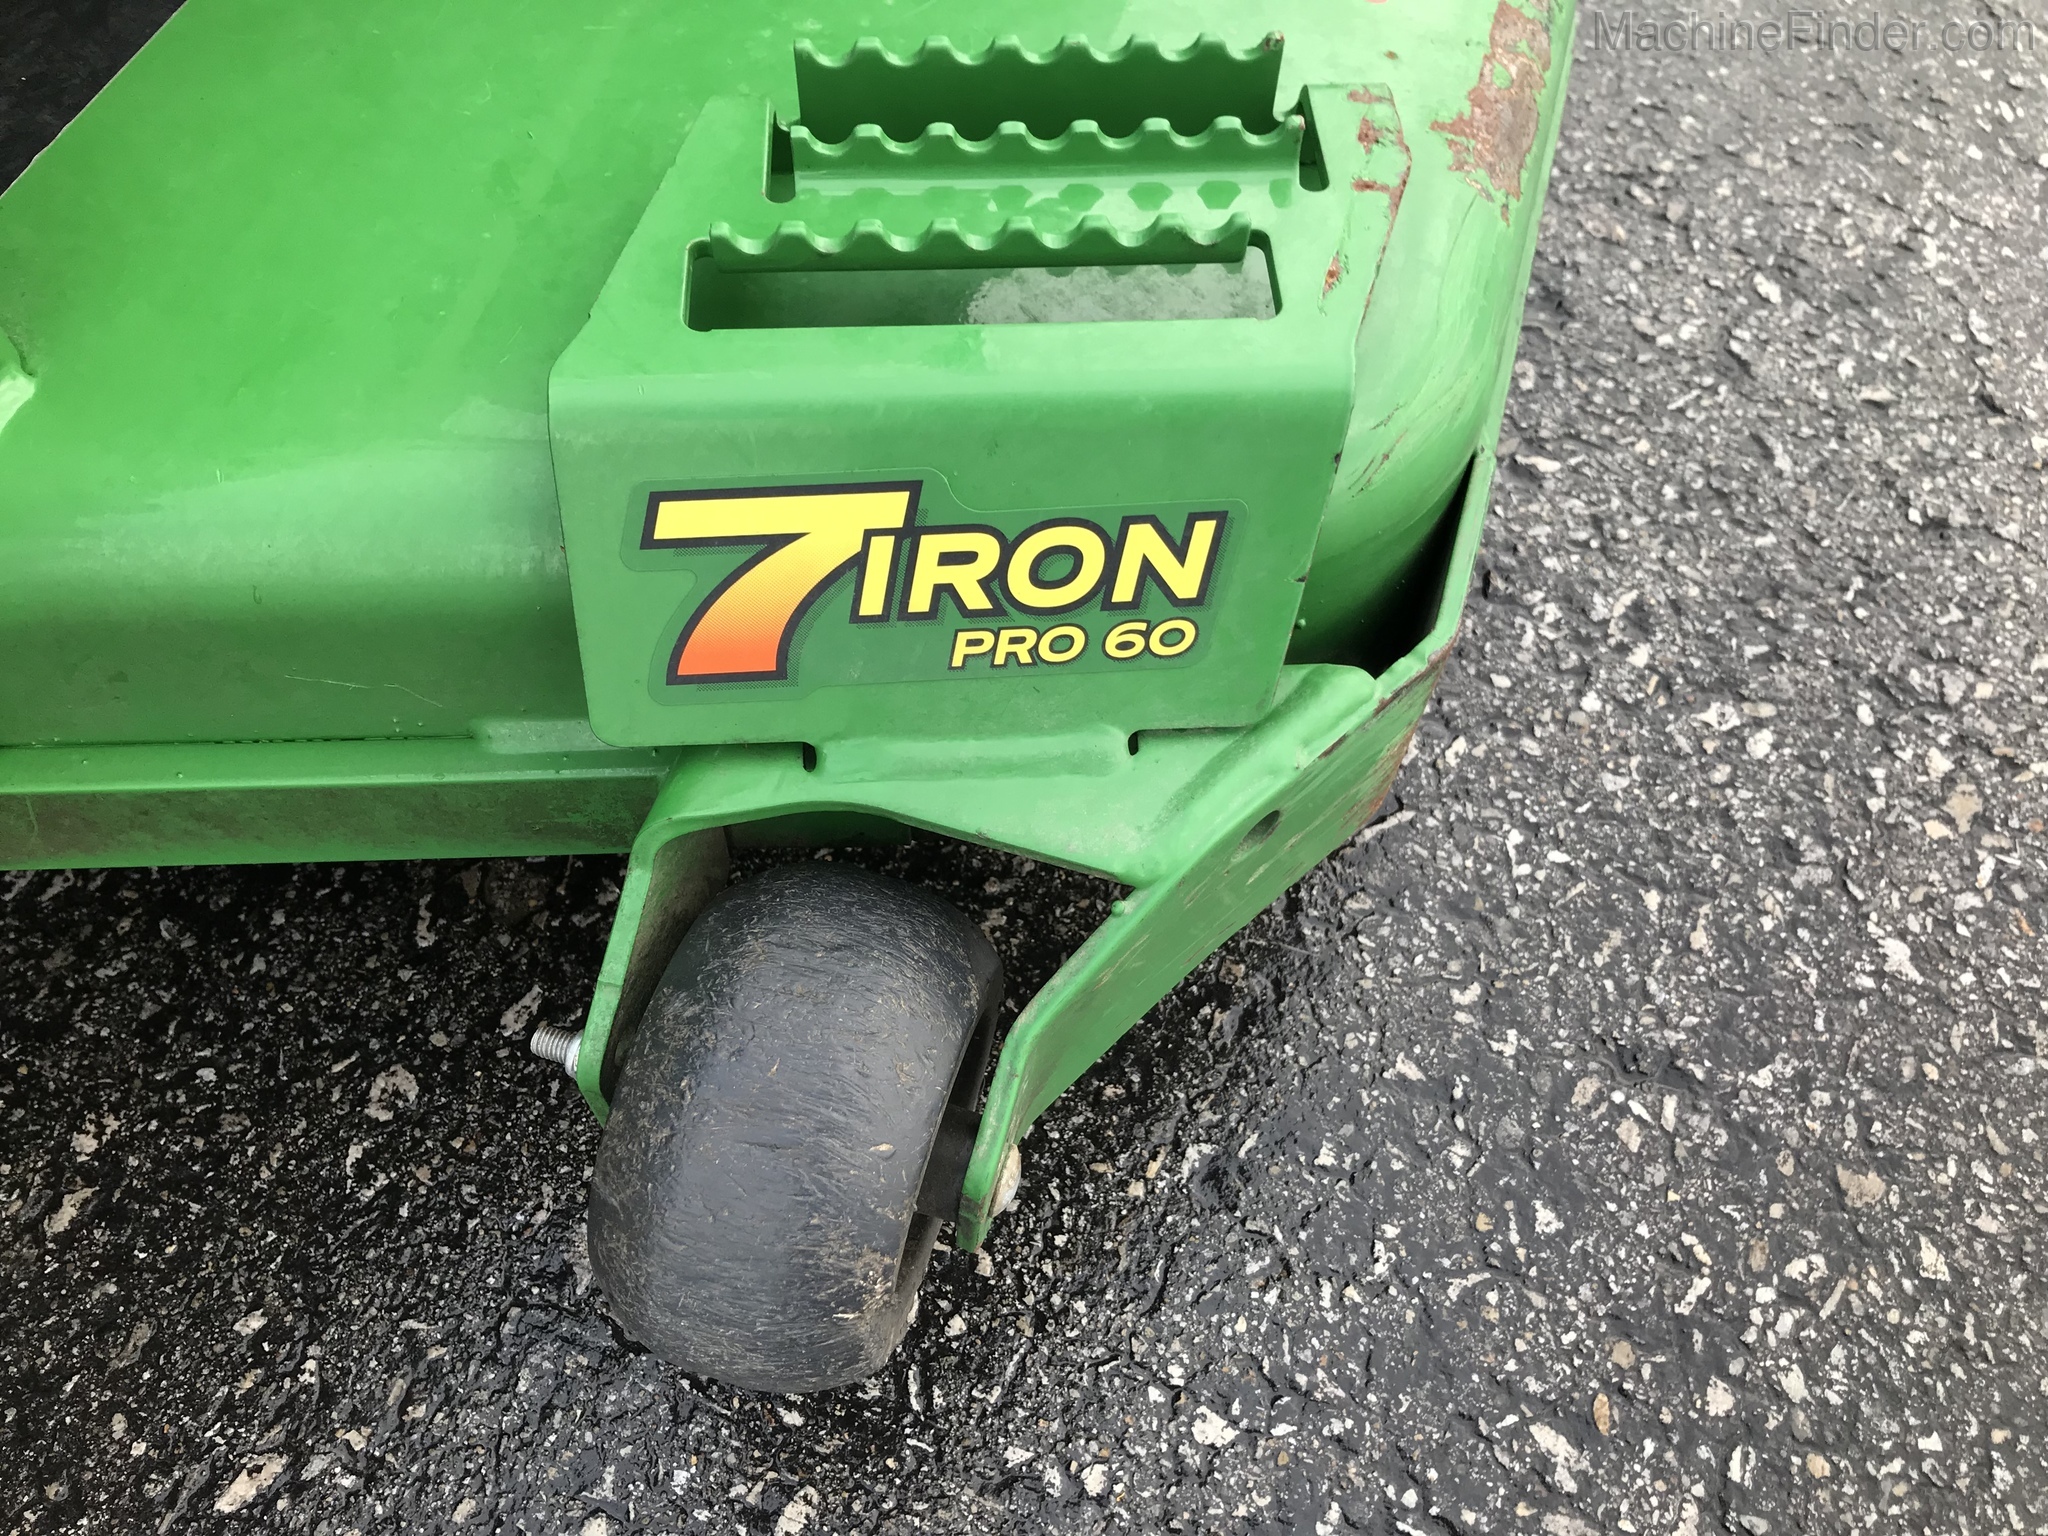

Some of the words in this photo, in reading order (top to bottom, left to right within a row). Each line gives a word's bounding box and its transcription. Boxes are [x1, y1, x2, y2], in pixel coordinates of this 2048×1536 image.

[645, 484, 919, 681] 7
[853, 514, 1227, 620] IRON
[950, 626, 1086, 668] PRO
[1103, 618, 1197, 660] 60
